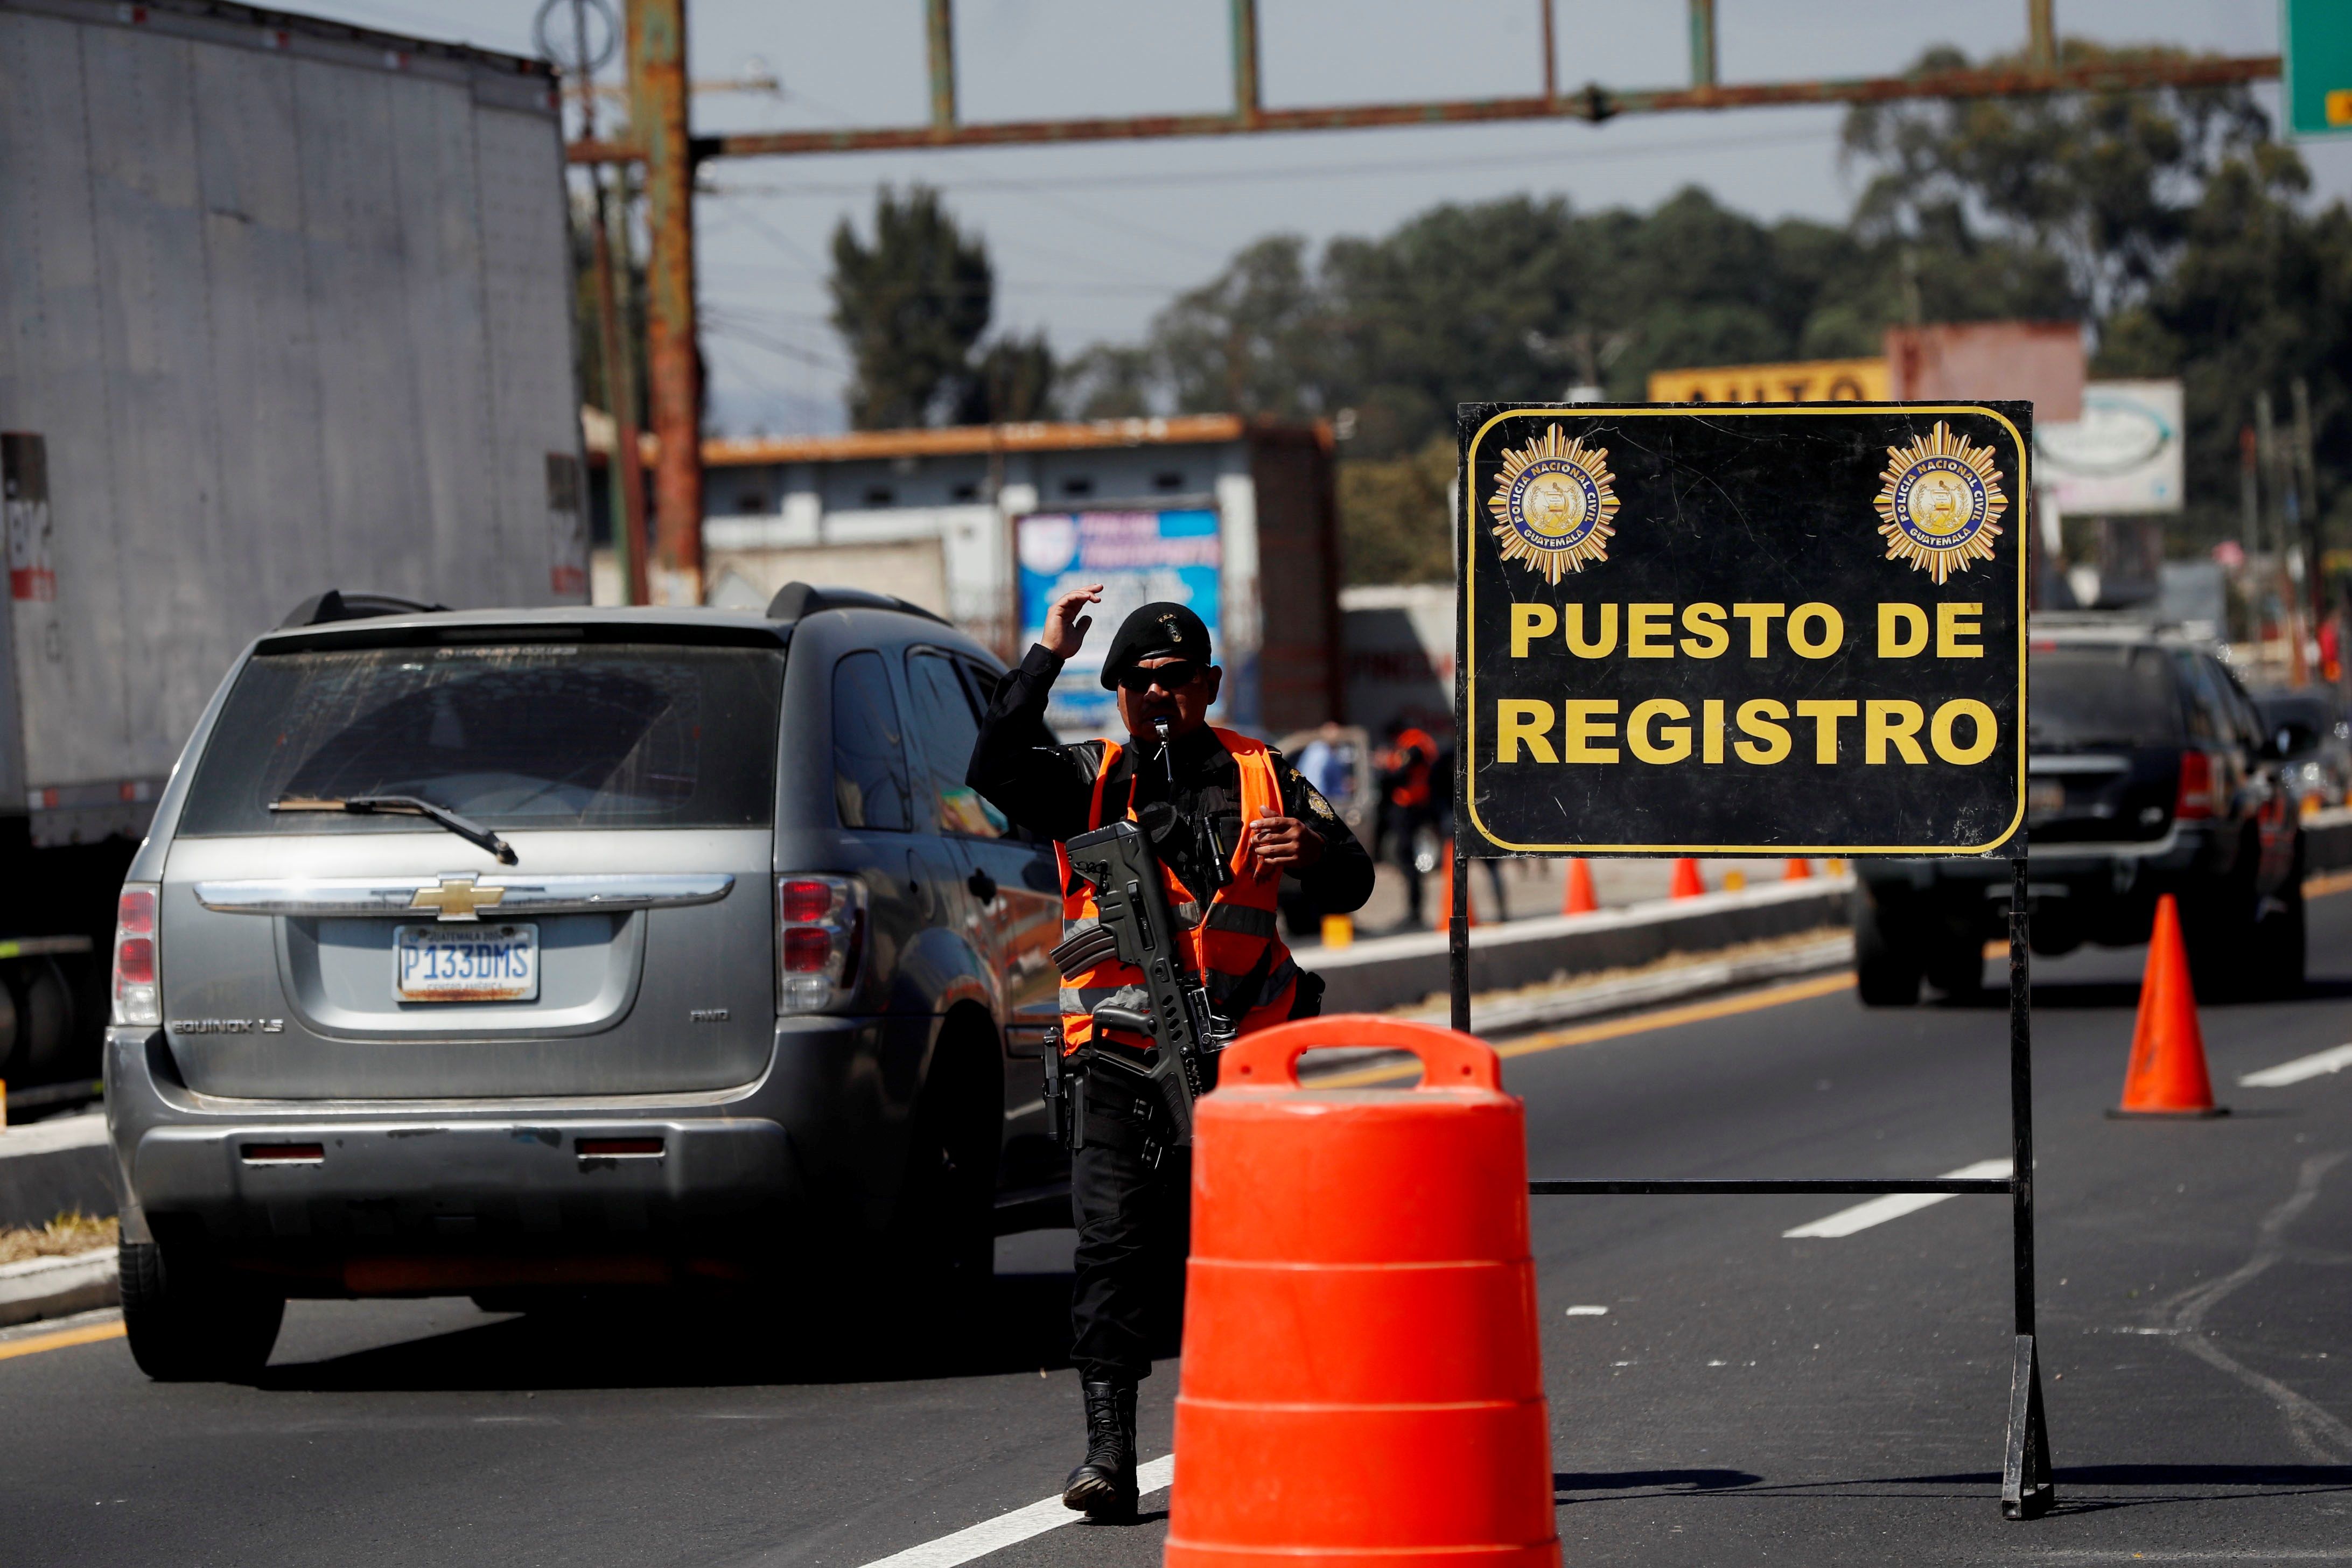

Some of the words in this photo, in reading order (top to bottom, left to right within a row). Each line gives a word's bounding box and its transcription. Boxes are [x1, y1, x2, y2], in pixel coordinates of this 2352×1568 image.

[1511, 475, 1531, 523] POLICIA
[1530, 462, 1592, 490] NACIONAL
[1585, 492, 1596, 522] CIVIL
[1898, 474, 1917, 522] POLICIA
[1916, 460, 1978, 488] NACIONAL
[1971, 490, 1983, 521] CIVIL
[1524, 529, 1585, 547] GUATEMALA
[1909, 528, 1971, 546] GUATEMALA
[1511, 602, 1844, 659] PUESTO
[1878, 603, 1984, 658] DE
[1497, 698, 1998, 765] REGISTRO
[172, 1019, 253, 1033] EQUINOX
[258, 1018, 284, 1033] LS
